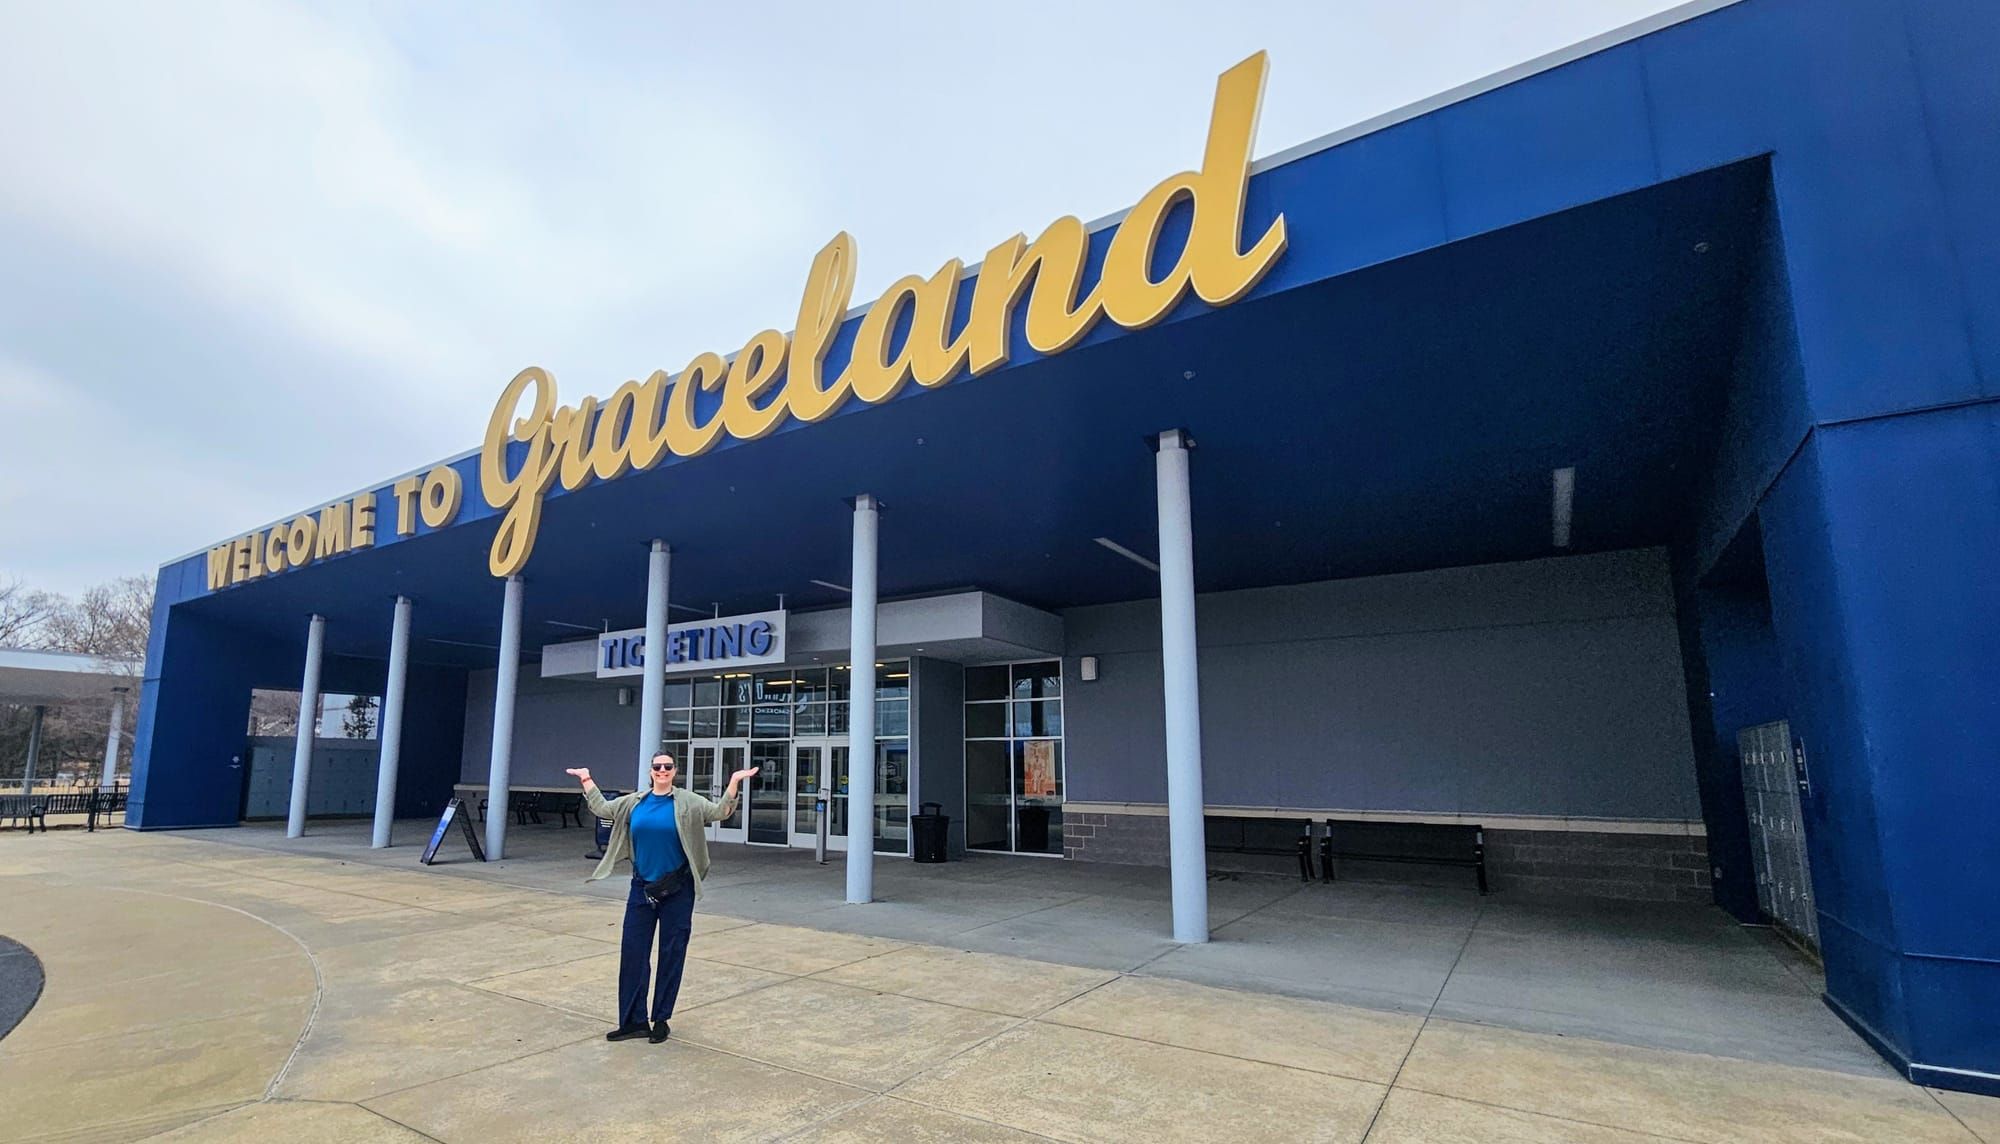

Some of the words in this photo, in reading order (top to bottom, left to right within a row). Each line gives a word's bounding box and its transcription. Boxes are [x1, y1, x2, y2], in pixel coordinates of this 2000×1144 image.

[207, 492, 376, 591] WELCOME
[394, 464, 462, 535] TO
[480, 49, 1288, 578] Graceland
[601, 620, 774, 669] TICETING
